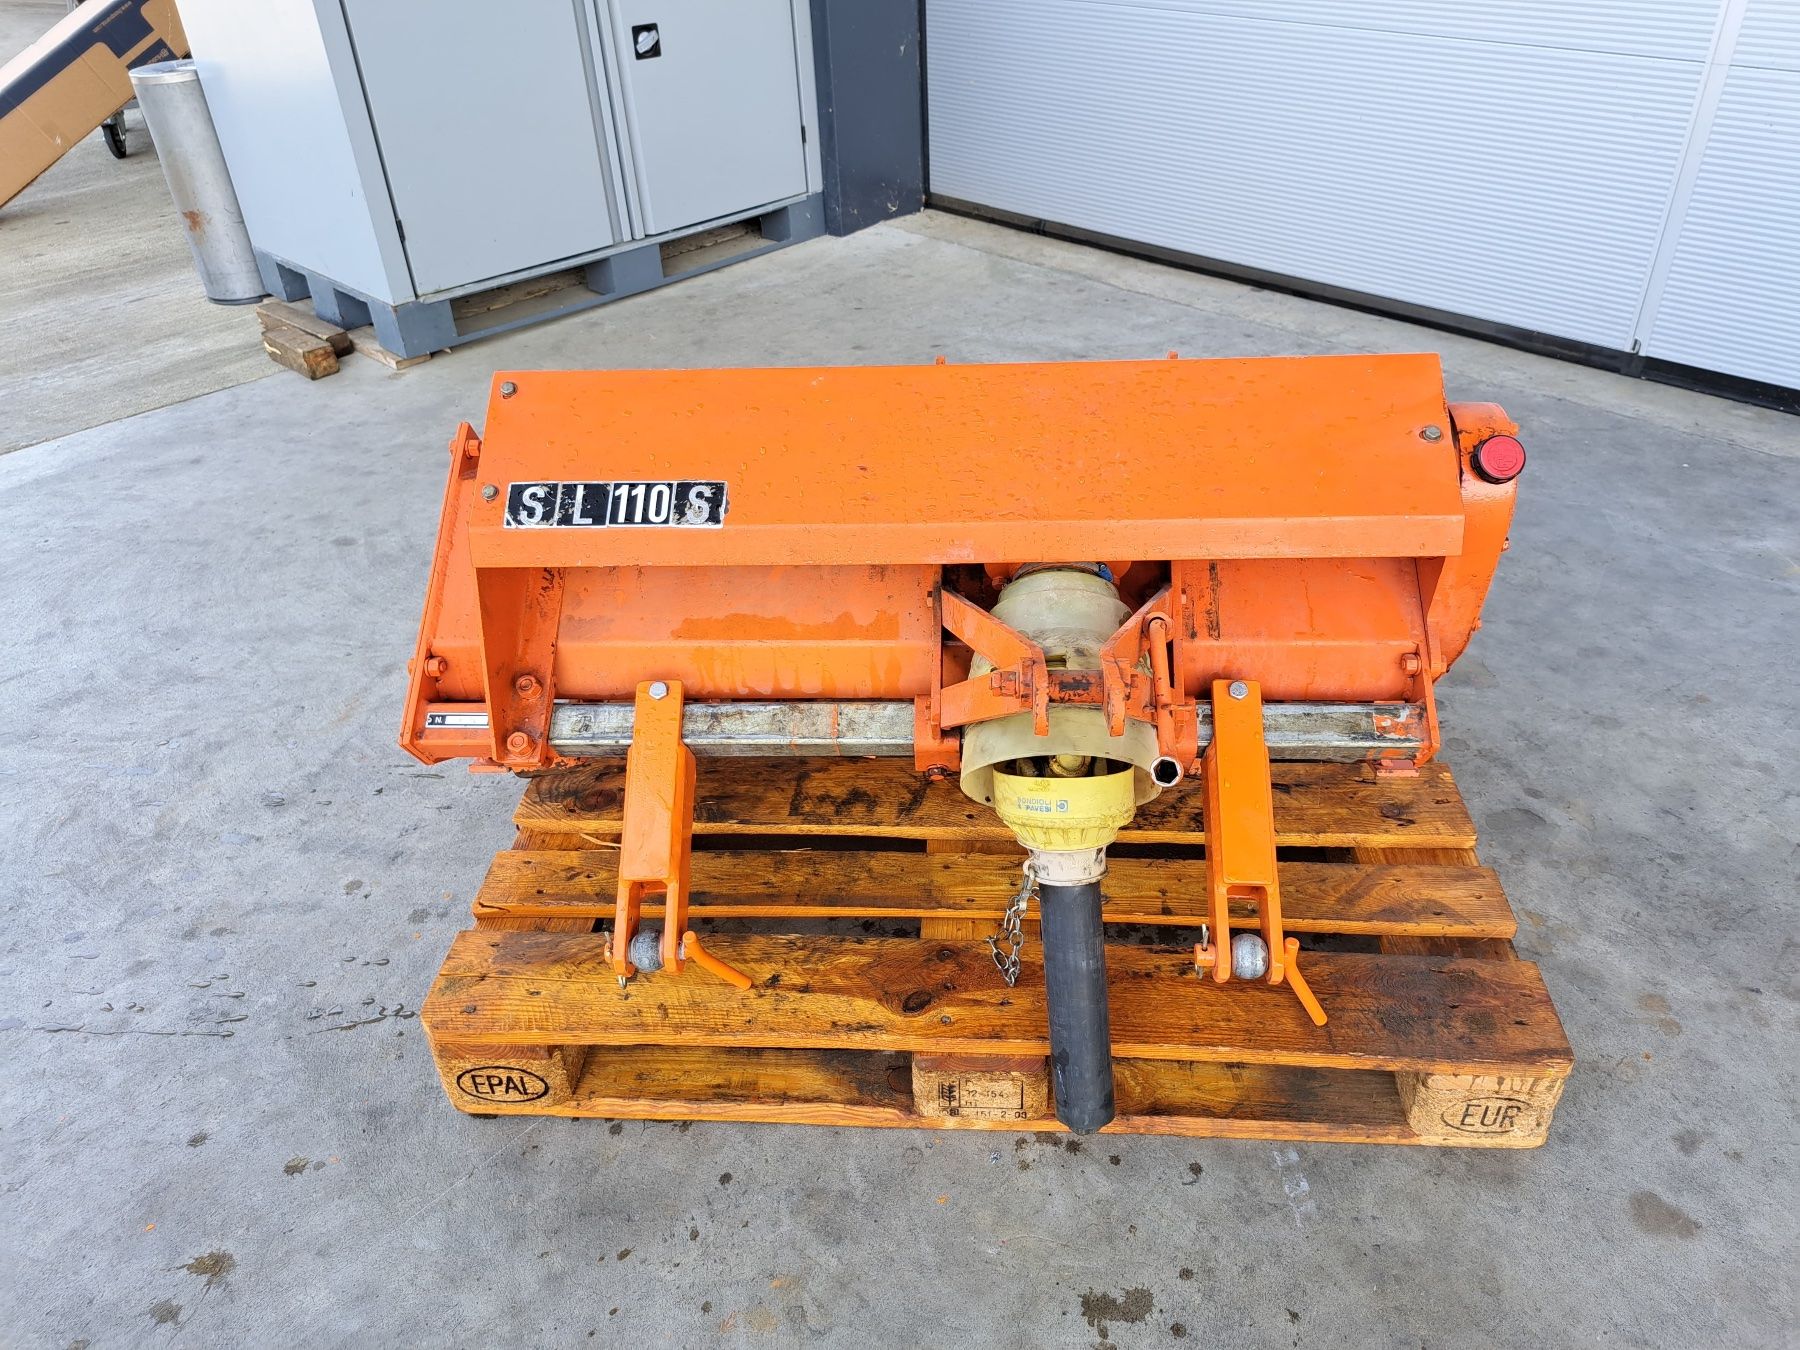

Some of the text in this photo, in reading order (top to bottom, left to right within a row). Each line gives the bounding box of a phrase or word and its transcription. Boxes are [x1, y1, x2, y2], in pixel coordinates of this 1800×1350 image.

[521, 484, 712, 525] S L 110 S
[470, 1074, 539, 1096] EPAL
[1460, 1103, 1523, 1128] EUR
